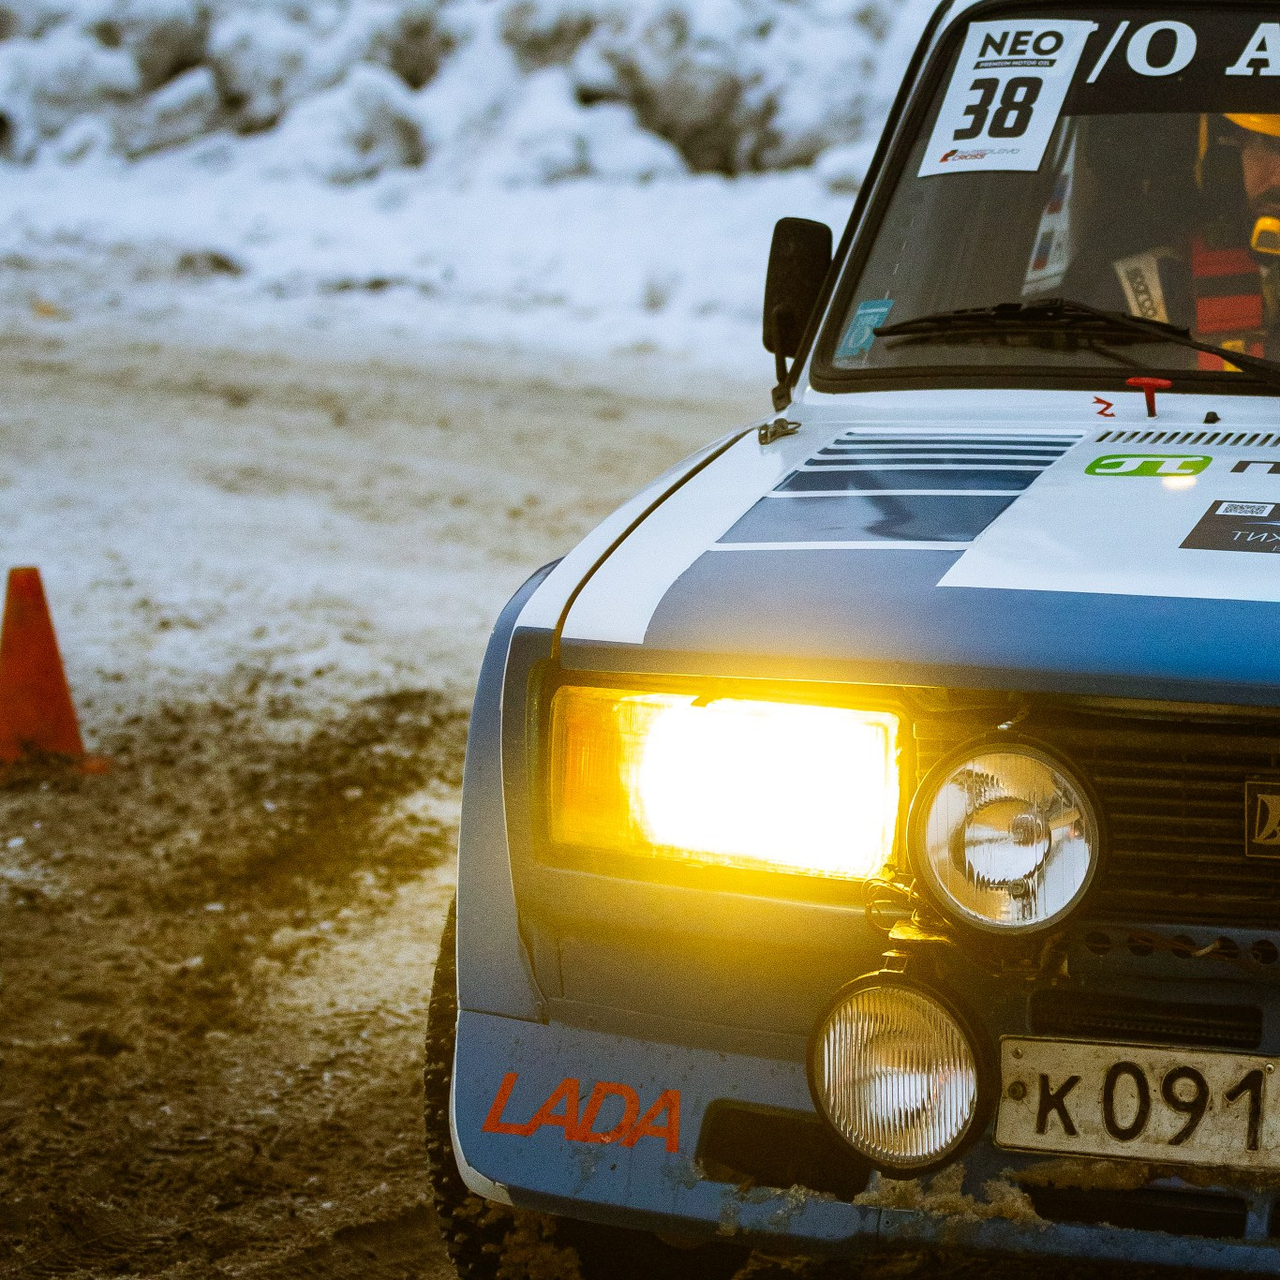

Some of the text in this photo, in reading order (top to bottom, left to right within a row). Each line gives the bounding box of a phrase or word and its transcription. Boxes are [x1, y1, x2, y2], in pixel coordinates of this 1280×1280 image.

[978, 30, 1064, 58] NEO
[1086, 21, 1198, 84] /O
[953, 76, 1044, 142] 38
[481, 1072, 681, 1153] LADA
